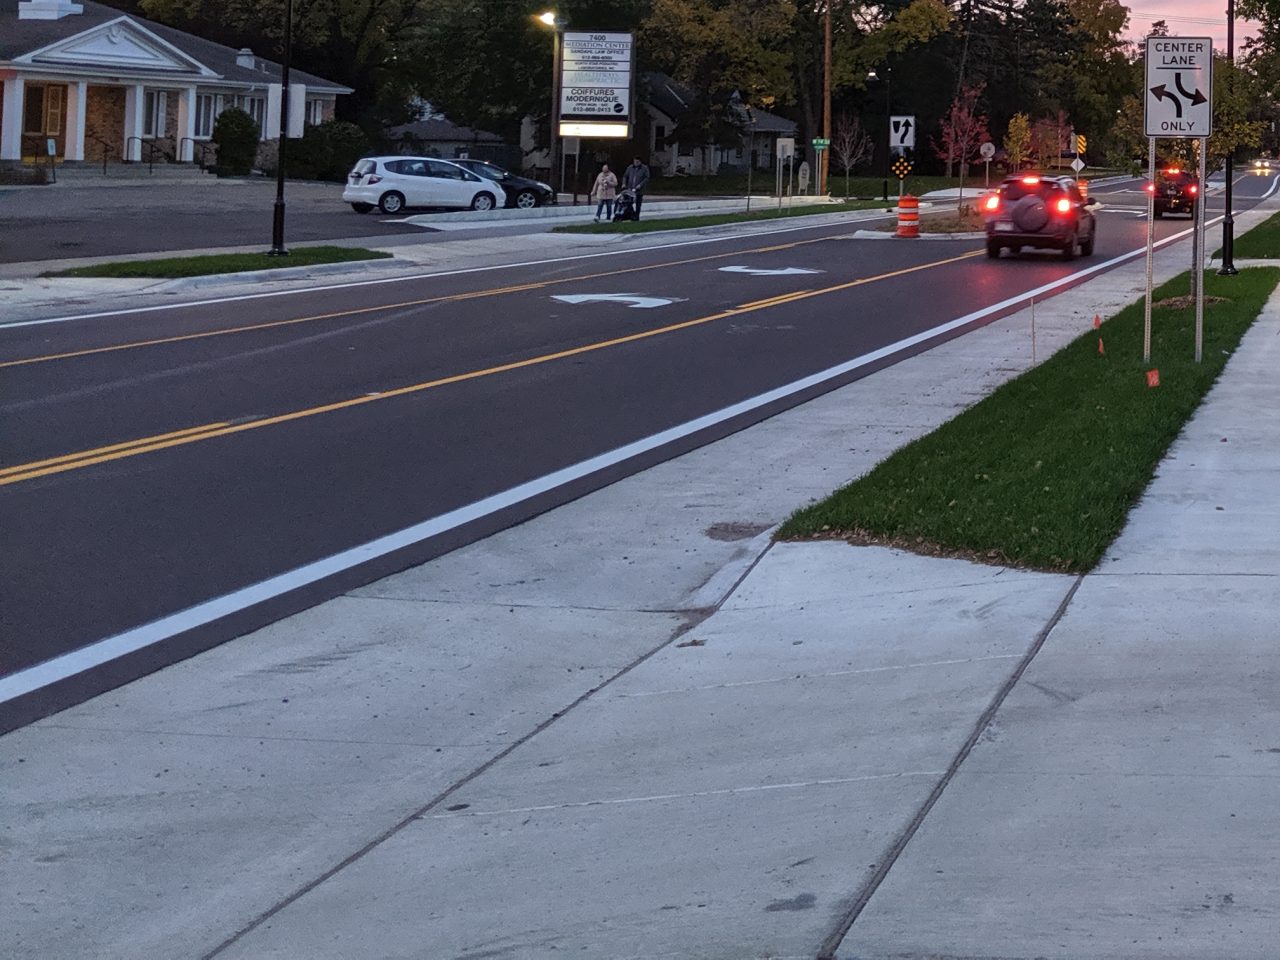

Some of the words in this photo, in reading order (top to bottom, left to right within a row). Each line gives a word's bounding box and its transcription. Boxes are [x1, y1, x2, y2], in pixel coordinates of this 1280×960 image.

[1155, 43, 1203, 52] CENTER
[1163, 55, 1195, 65] LANE
[1161, 121, 1195, 131] ONLY
